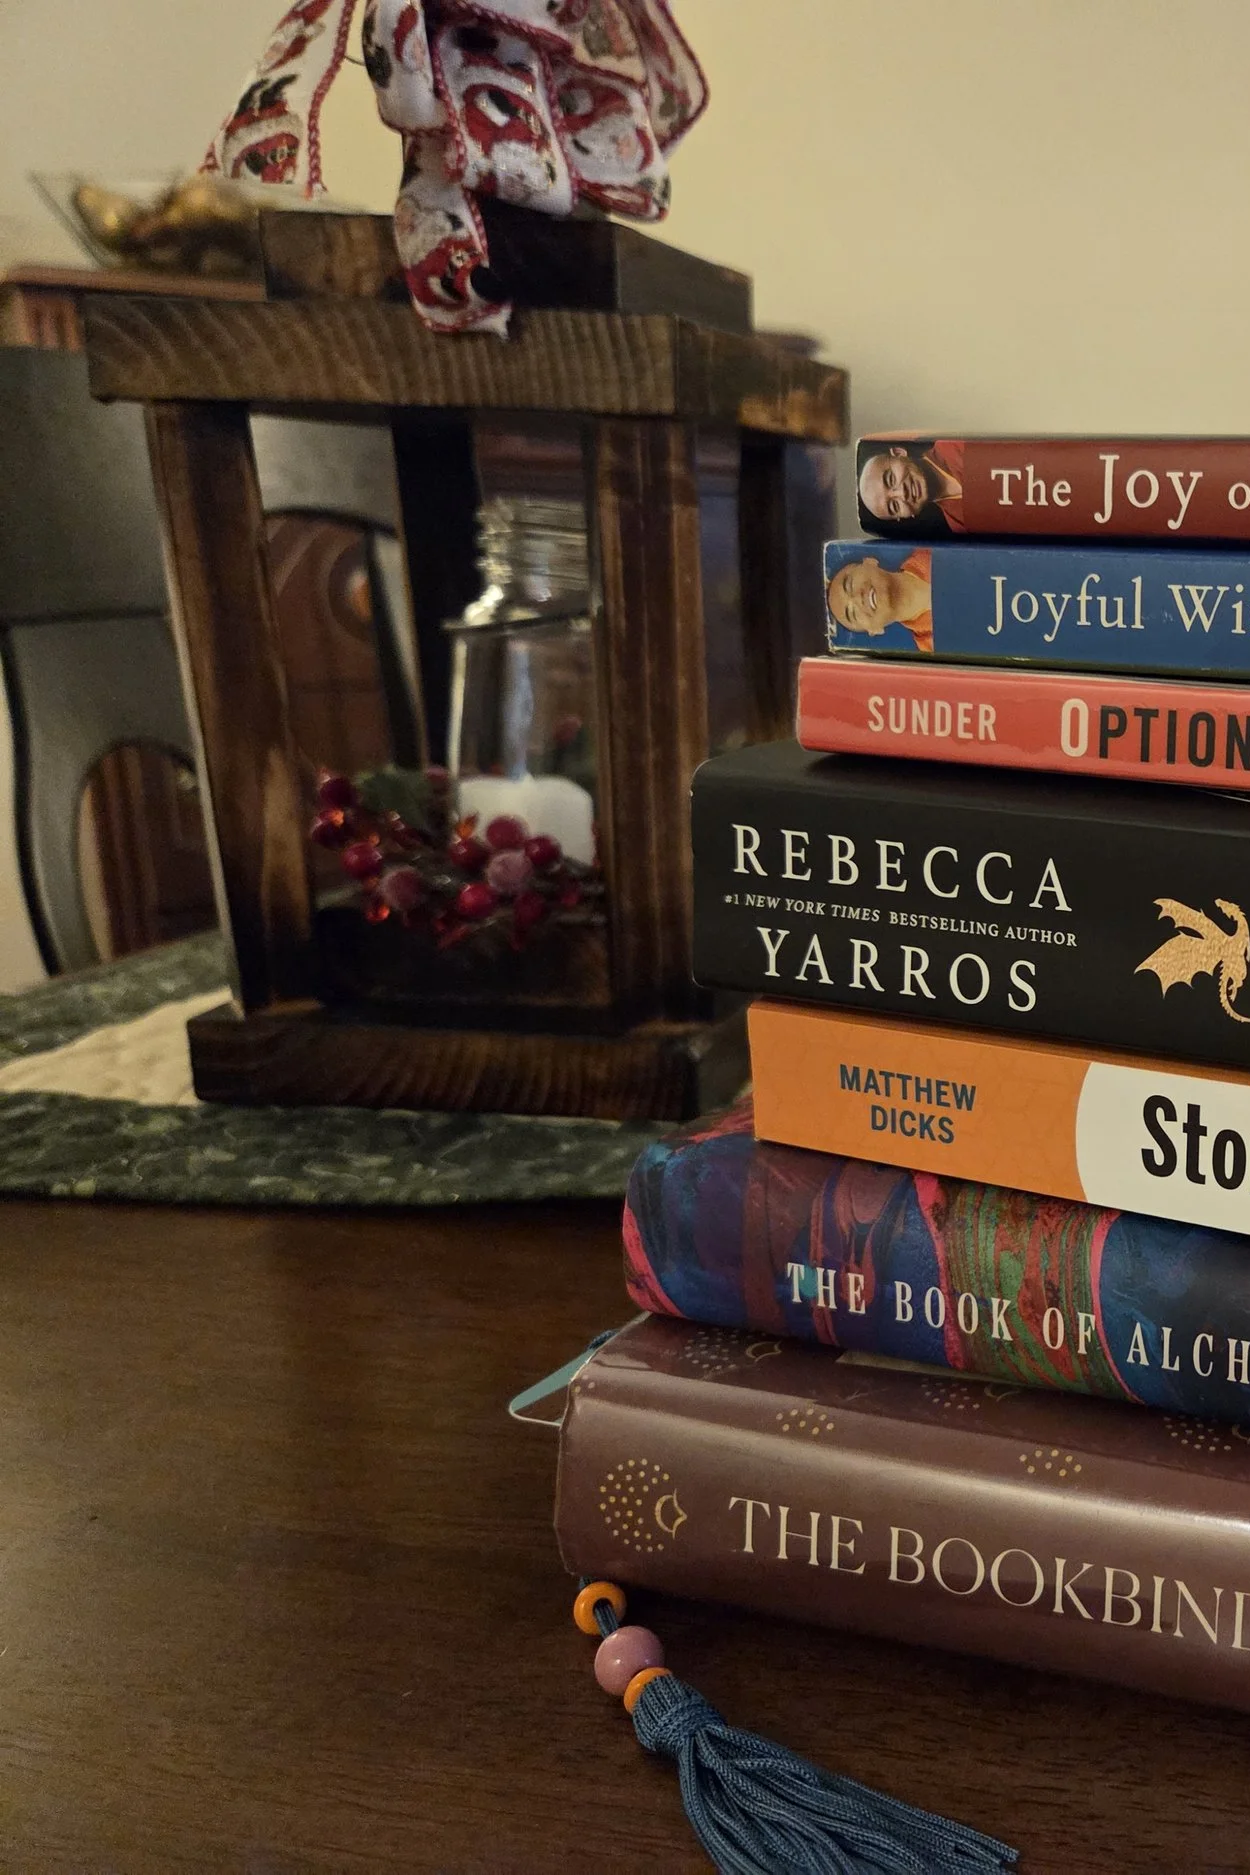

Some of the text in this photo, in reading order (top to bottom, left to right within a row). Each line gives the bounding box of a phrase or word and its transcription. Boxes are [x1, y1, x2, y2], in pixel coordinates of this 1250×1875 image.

[991, 467, 1072, 508] The
[1094, 453, 1203, 529] Joy
[987, 573, 1145, 643] Joyful
[867, 696, 997, 742] SUNDER
[730, 824, 1073, 912] REBECCA
[724, 894, 1078, 947] #1 NEW YORK TIMES BESTSELLING AUTHOR
[756, 927, 1038, 1013] YARROS
[839, 1064, 976, 1112] MATTHEW
[870, 1105, 955, 1145] DICKS
[786, 1262, 866, 1314] THE
[895, 1281, 1014, 1342] BOOK
[1042, 1307, 1096, 1355] OF
[729, 1496, 865, 1574] THE
